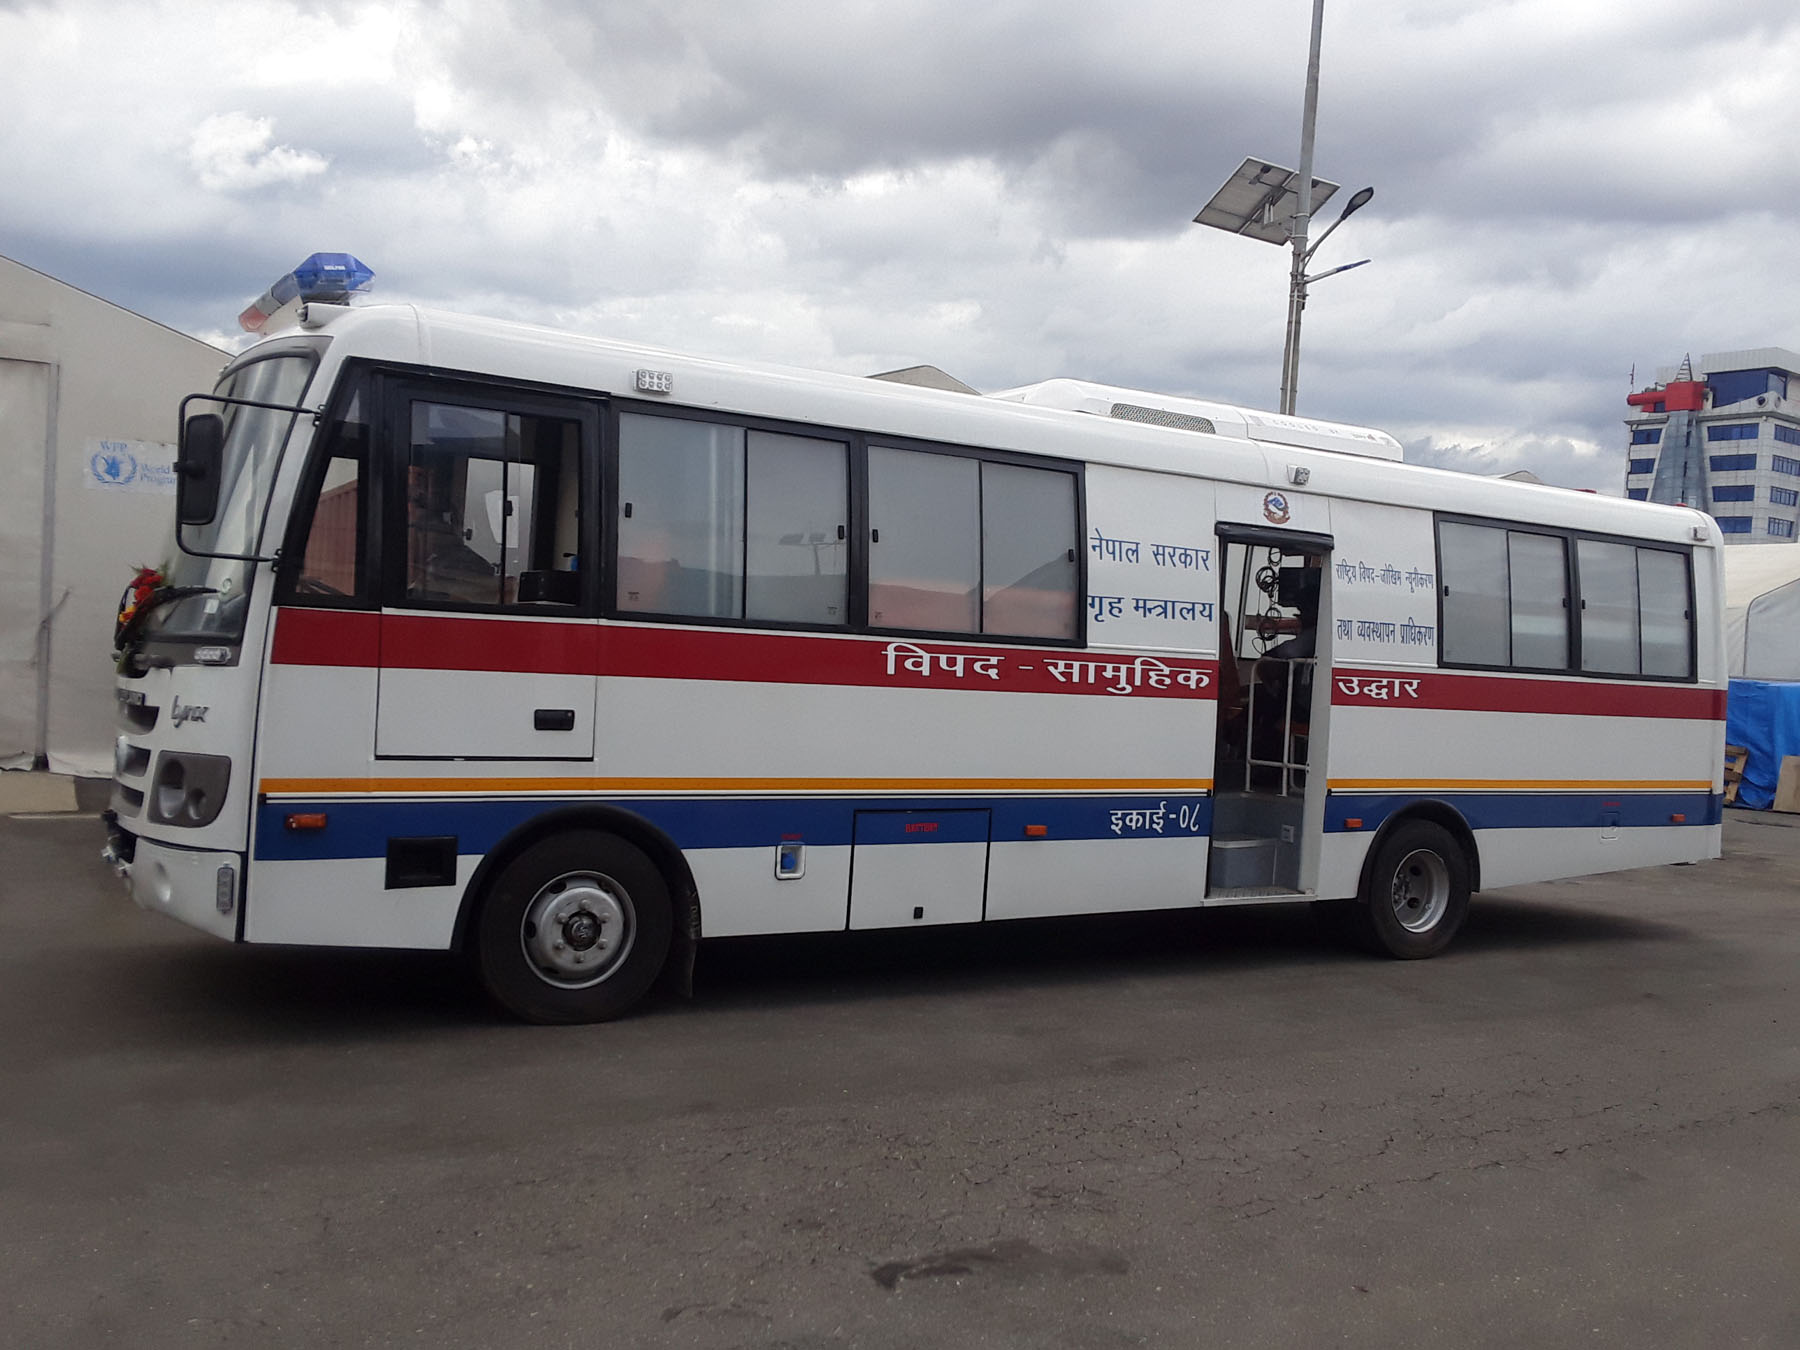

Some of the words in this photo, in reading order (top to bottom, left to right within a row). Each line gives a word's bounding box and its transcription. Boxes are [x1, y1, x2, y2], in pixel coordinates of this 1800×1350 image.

[100, 440, 128, 453] WFP
[140, 463, 169, 475] World
[1090, 528, 1141, 564] नेपाल
[1150, 543, 1211, 572] सरकार
[1336, 558, 1356, 585] राष्ट्रिय
[1088, 594, 1125, 623] गृह
[1132, 597, 1214, 622] मन्त्रालय
[1337, 619, 1352, 641] तथा
[1357, 620, 1395, 644] व्यवस्थापन
[1400, 616, 1434, 647] प्राधिकरण
[881, 642, 1005, 680] विपद
[1043, 656, 1213, 694] सामुहिक
[1335, 676, 1421, 700] उद्धार
